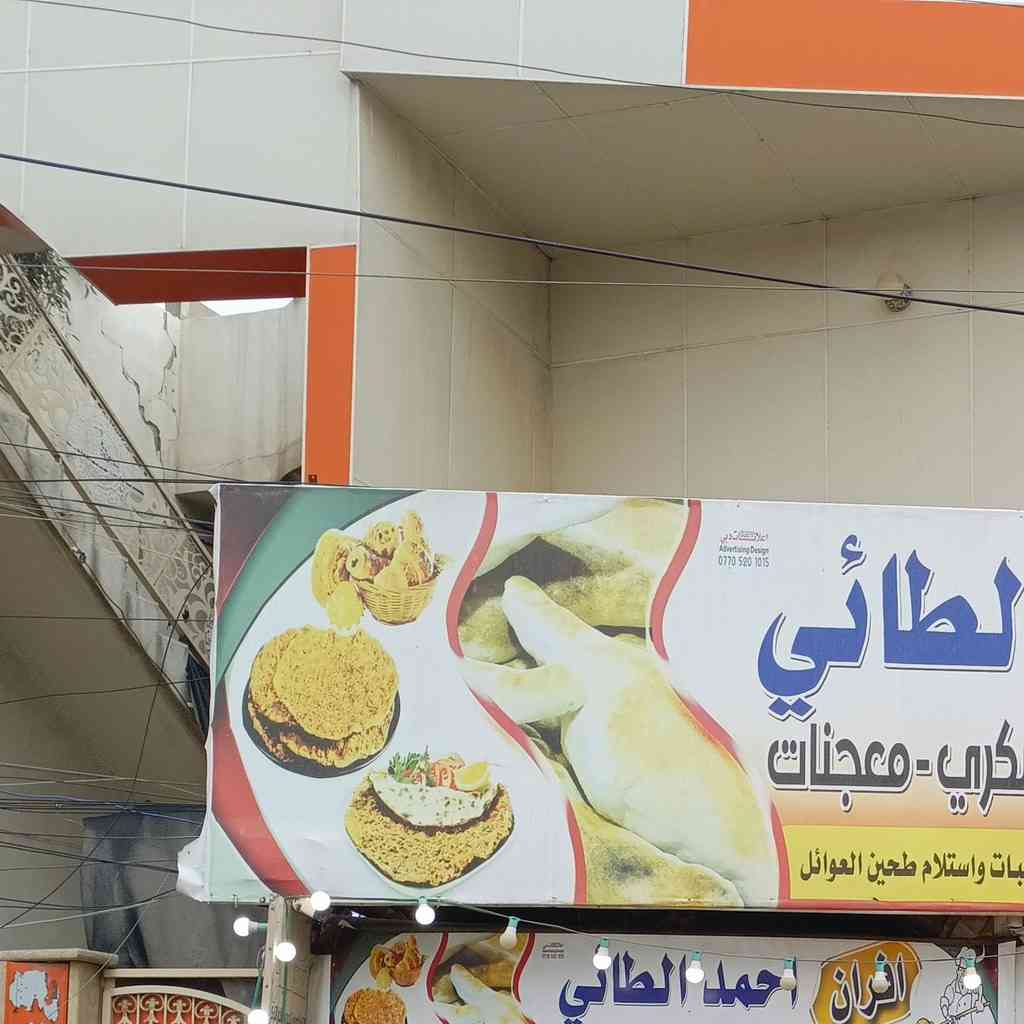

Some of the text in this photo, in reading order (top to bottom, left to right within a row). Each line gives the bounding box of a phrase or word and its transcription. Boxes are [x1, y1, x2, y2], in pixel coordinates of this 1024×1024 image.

[718, 556, 736, 567] 0770
[768, 721, 913, 815] معجنات
[799, 847, 863, 883] العوائل
[867, 850, 917, 886] طحين
[922, 851, 985, 885] واستلام
